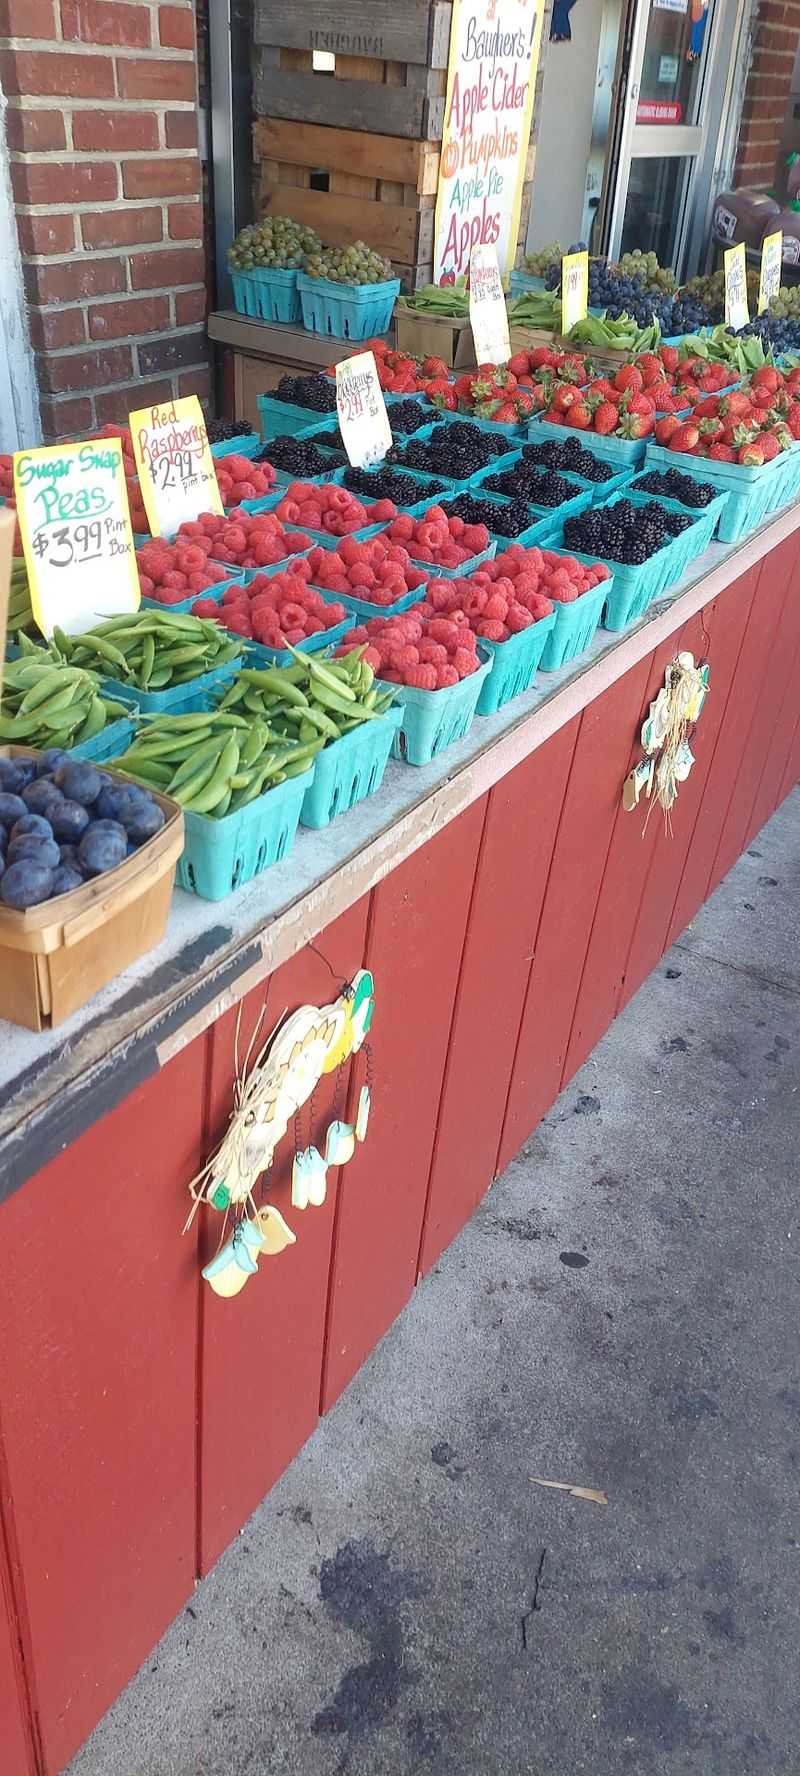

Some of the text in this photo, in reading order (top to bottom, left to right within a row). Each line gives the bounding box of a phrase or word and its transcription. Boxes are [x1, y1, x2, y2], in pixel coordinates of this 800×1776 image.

[447, 62, 529, 134] Apple Cider
[459, 116, 518, 176] Pumpkins
[449, 165, 504, 215] Apple Pie
[440, 195, 500, 272] Apples
[151, 400, 180, 430] Red
[16, 455, 75, 487] Sugar
[33, 485, 106, 524] Peas
[109, 537, 132, 557] Box
